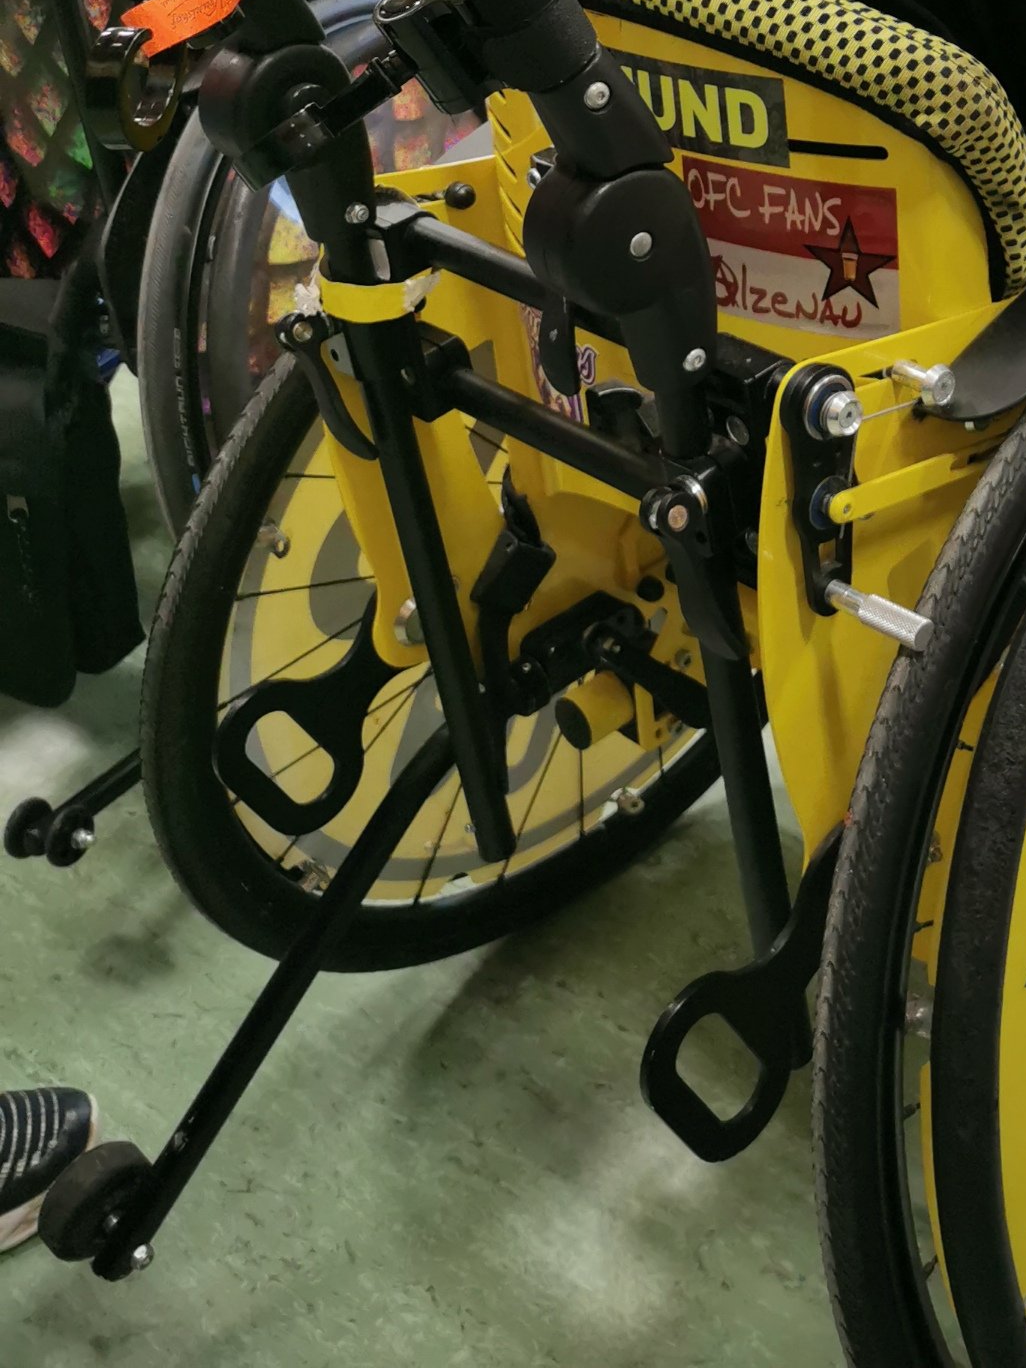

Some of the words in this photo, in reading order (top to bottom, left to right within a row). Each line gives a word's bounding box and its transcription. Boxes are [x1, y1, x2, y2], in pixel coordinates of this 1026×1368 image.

[621, 65, 769, 149] UND
[687, 168, 751, 218] OFC
[758, 184, 842, 236] FANS
